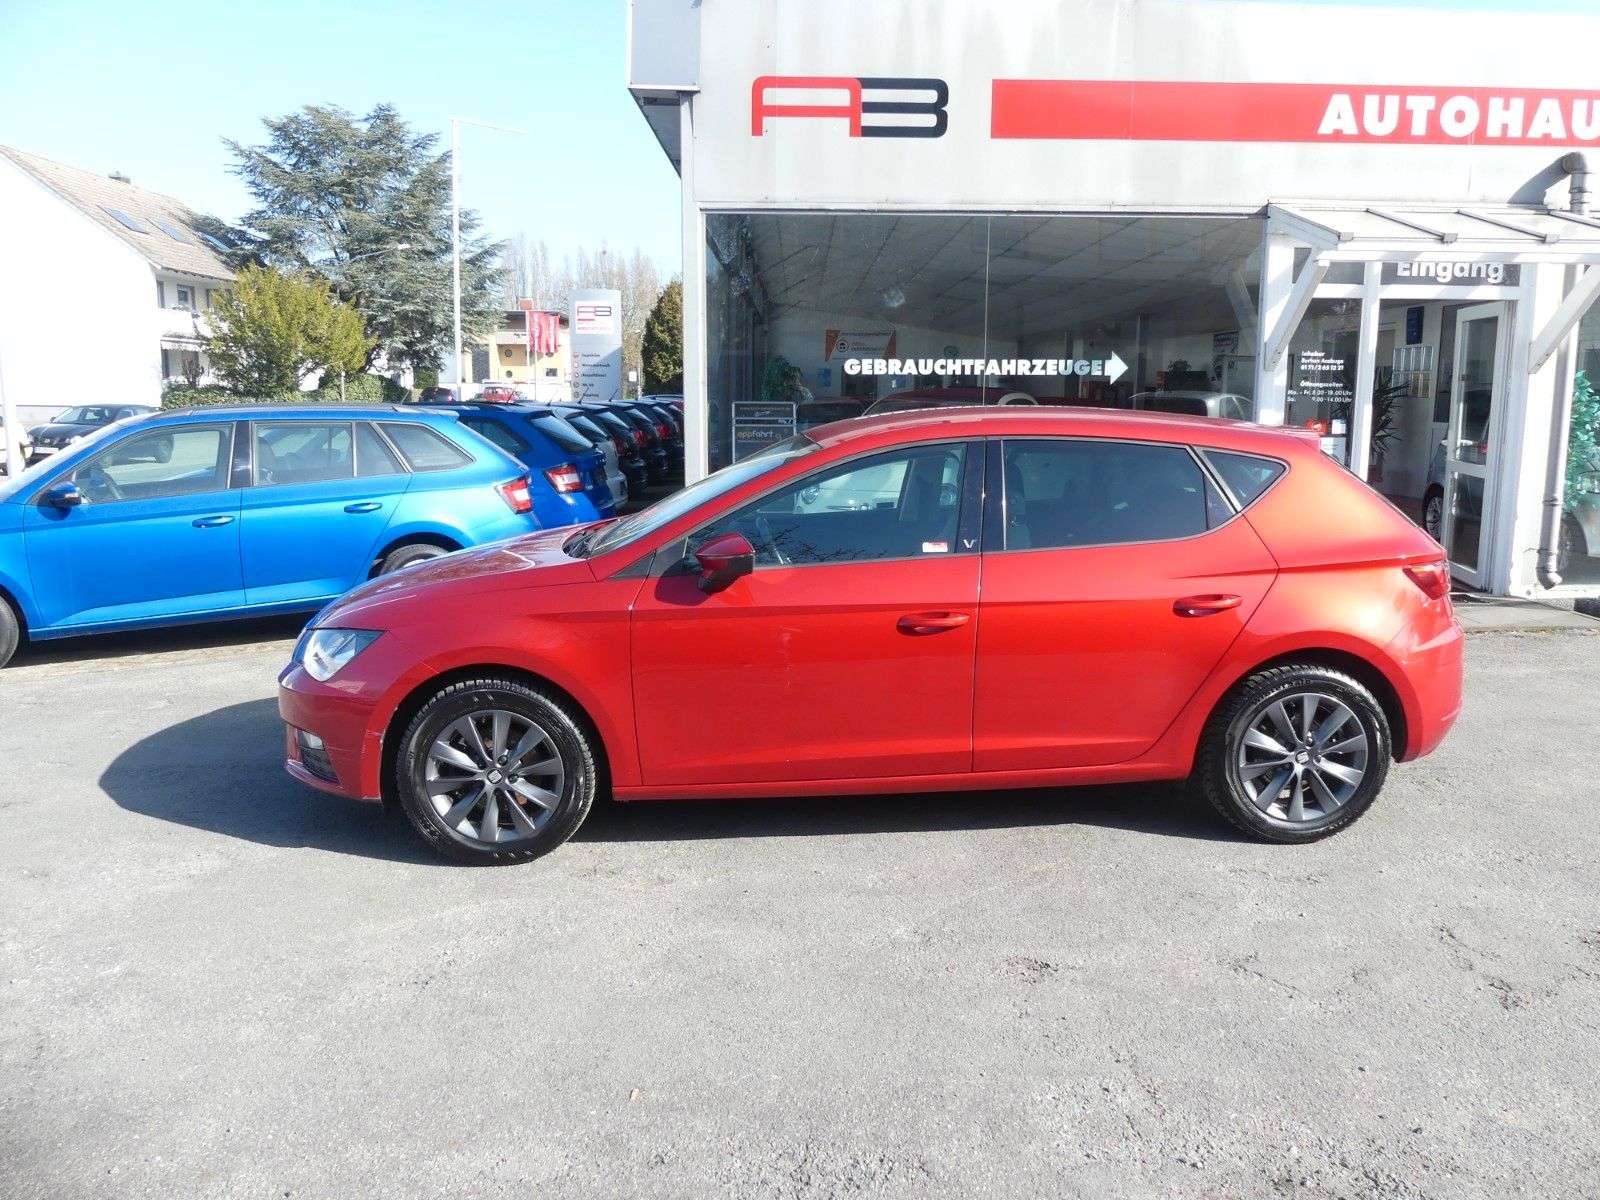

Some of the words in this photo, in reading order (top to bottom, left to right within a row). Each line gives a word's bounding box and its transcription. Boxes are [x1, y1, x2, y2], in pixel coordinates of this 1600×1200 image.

[752, 76, 949, 138] AB
[1397, 262, 1504, 284] Eingang
[844, 358, 1103, 376] GEBRAUCHTFAHRZEUGE
